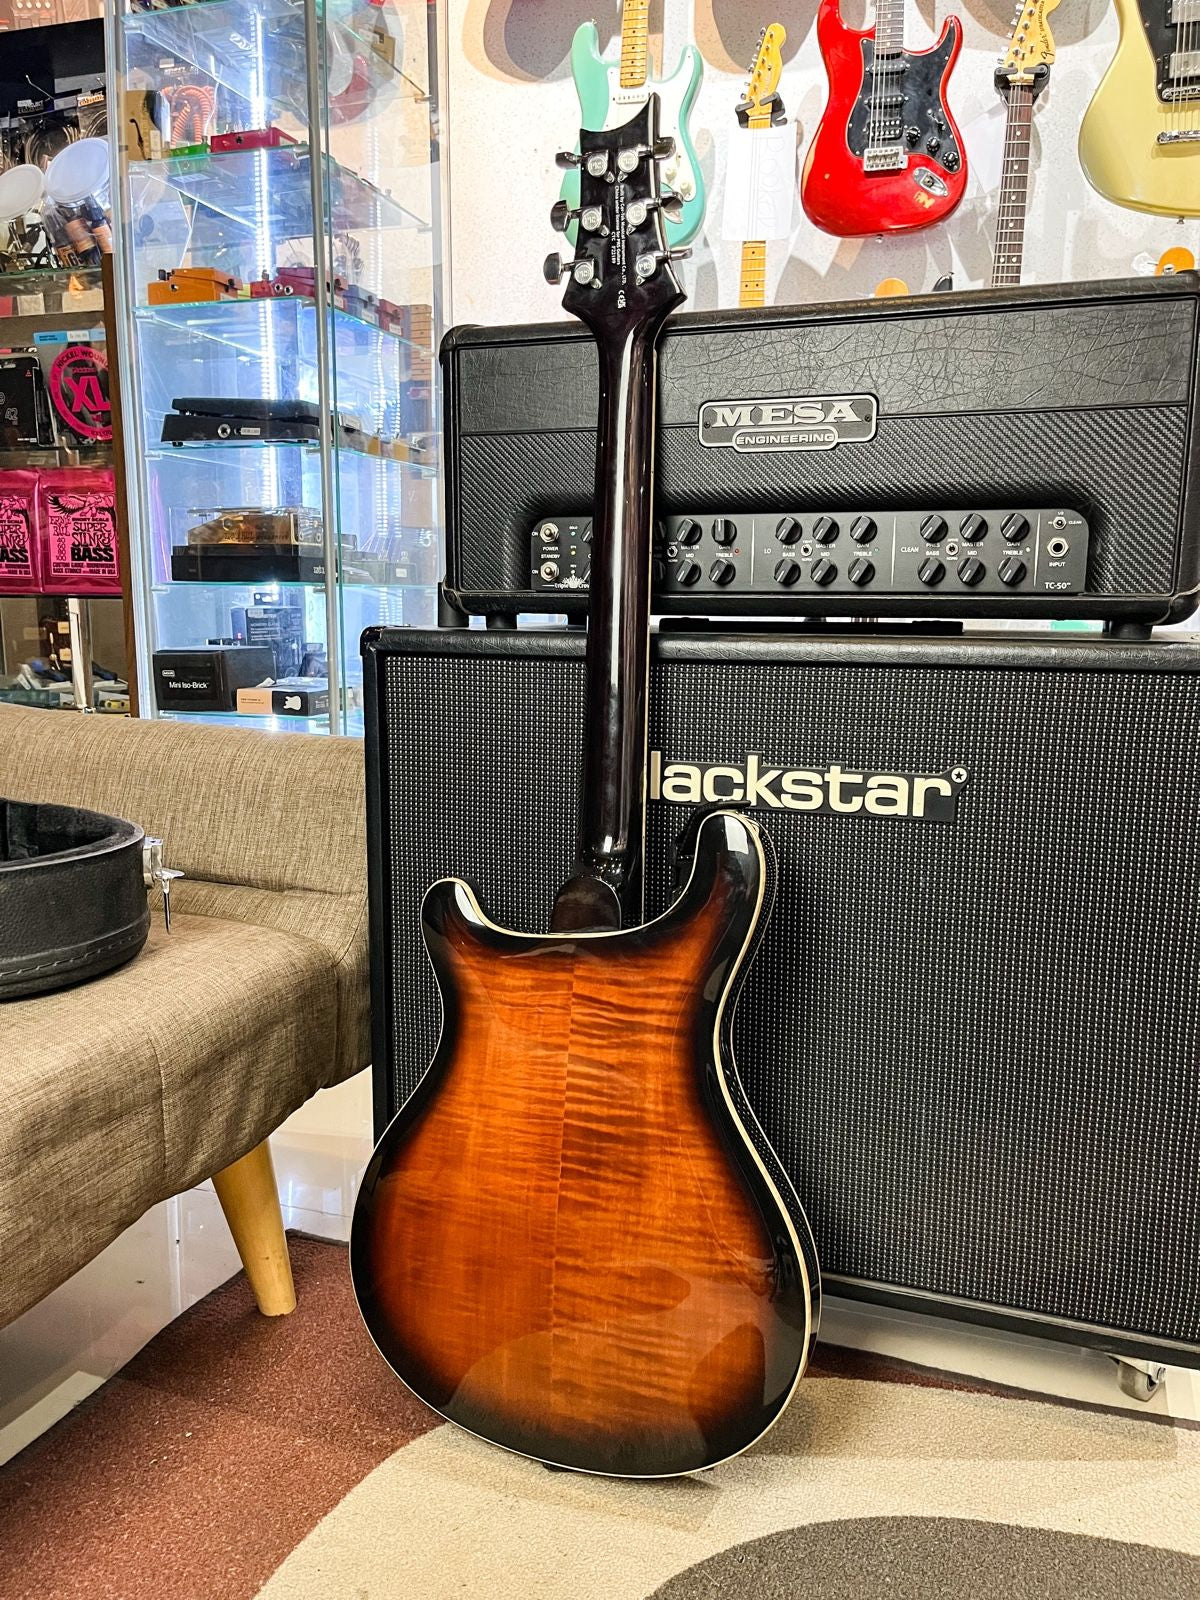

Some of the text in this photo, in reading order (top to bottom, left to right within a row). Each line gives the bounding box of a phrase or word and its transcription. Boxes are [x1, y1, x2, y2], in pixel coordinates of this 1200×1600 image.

[1040, 34, 1054, 59] Fender
[56, 350, 79, 368] NICKEL
[712, 401, 862, 427] MESA
[736, 433, 835, 445] ENGINEERING
[0, 524, 26, 534] PER
[73, 521, 111, 532] SUPER
[0, 533, 28, 549] INKY
[71, 532, 115, 548] SLINKY
[0, 548, 29, 563] ASS
[71, 546, 114, 562] BASS
[169, 681, 181, 689] Mini
[650, 750, 952, 818] lackstar
